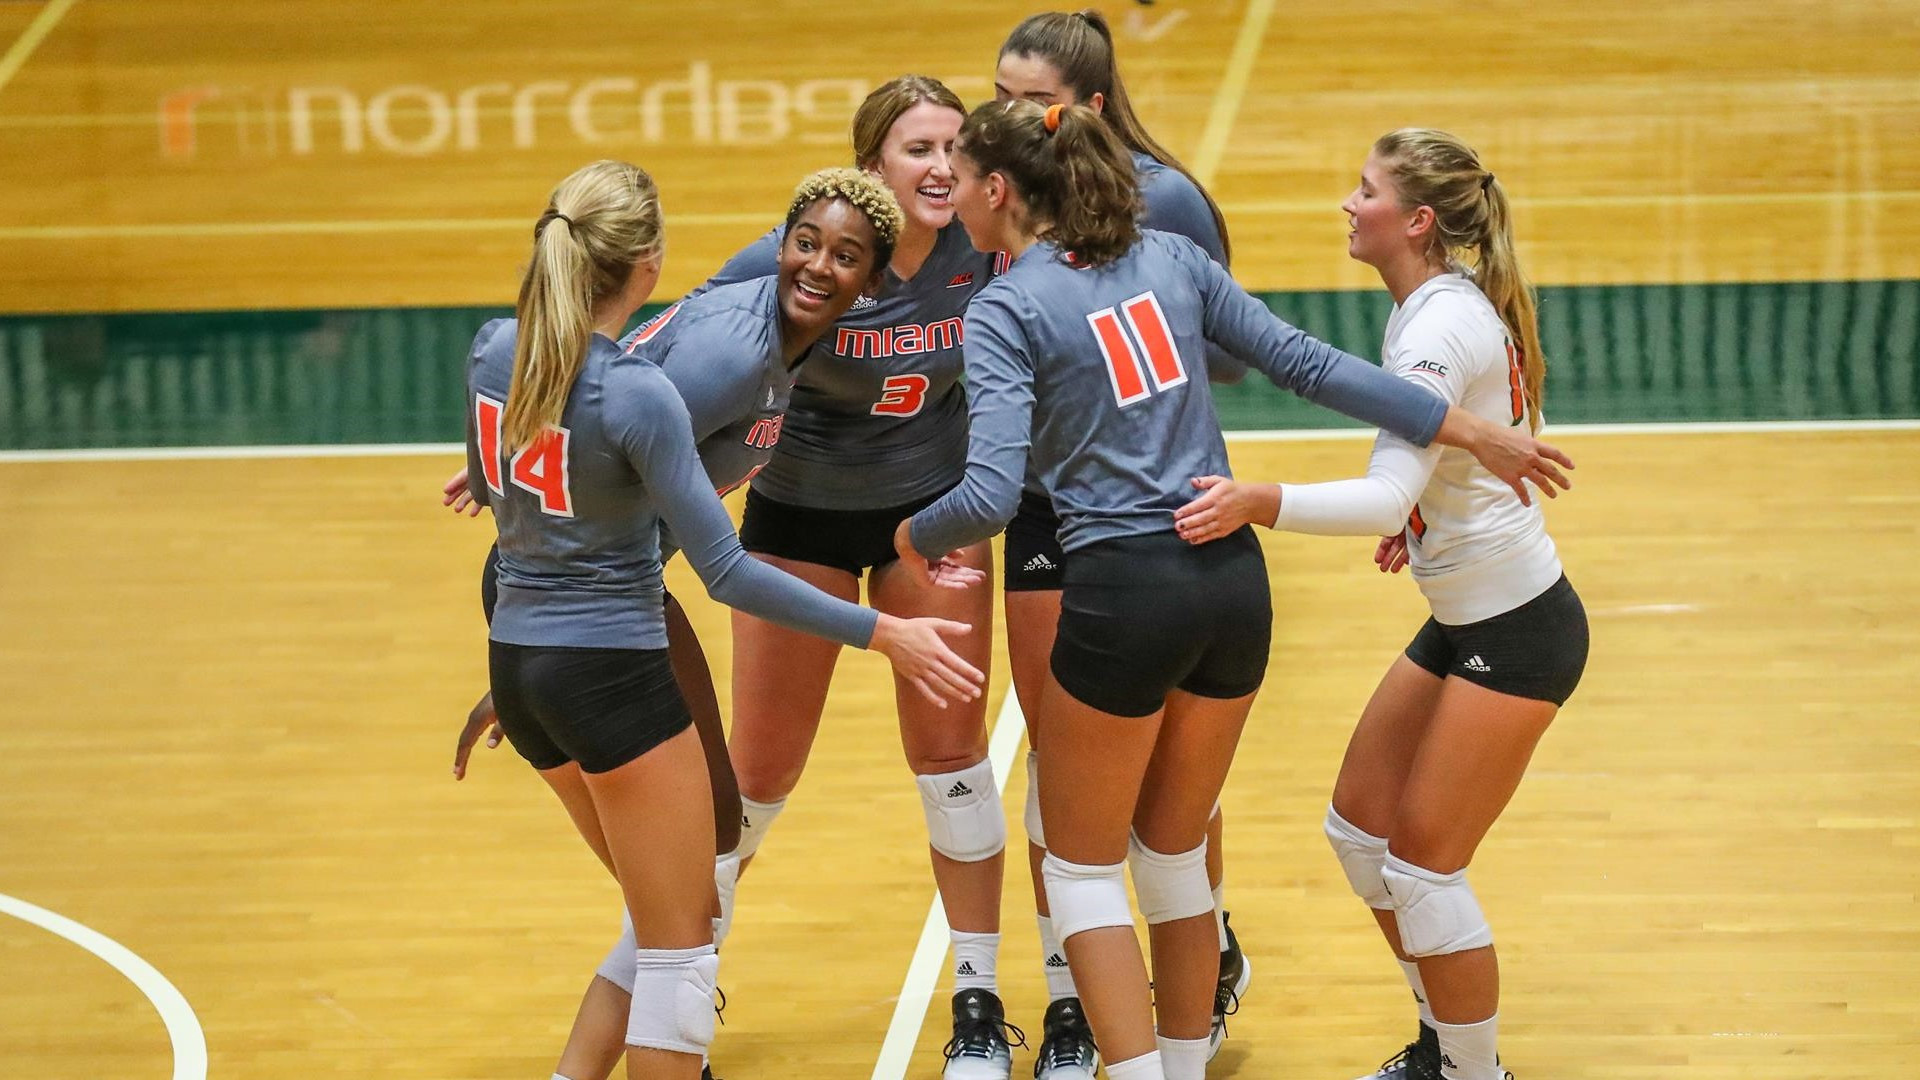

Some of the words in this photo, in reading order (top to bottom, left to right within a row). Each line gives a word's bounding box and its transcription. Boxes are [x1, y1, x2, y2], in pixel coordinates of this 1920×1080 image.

[1086, 290, 1188, 408] 11
[1412, 359, 1449, 376] ACC
[870, 373, 930, 418] 3
[475, 391, 575, 518] 14
